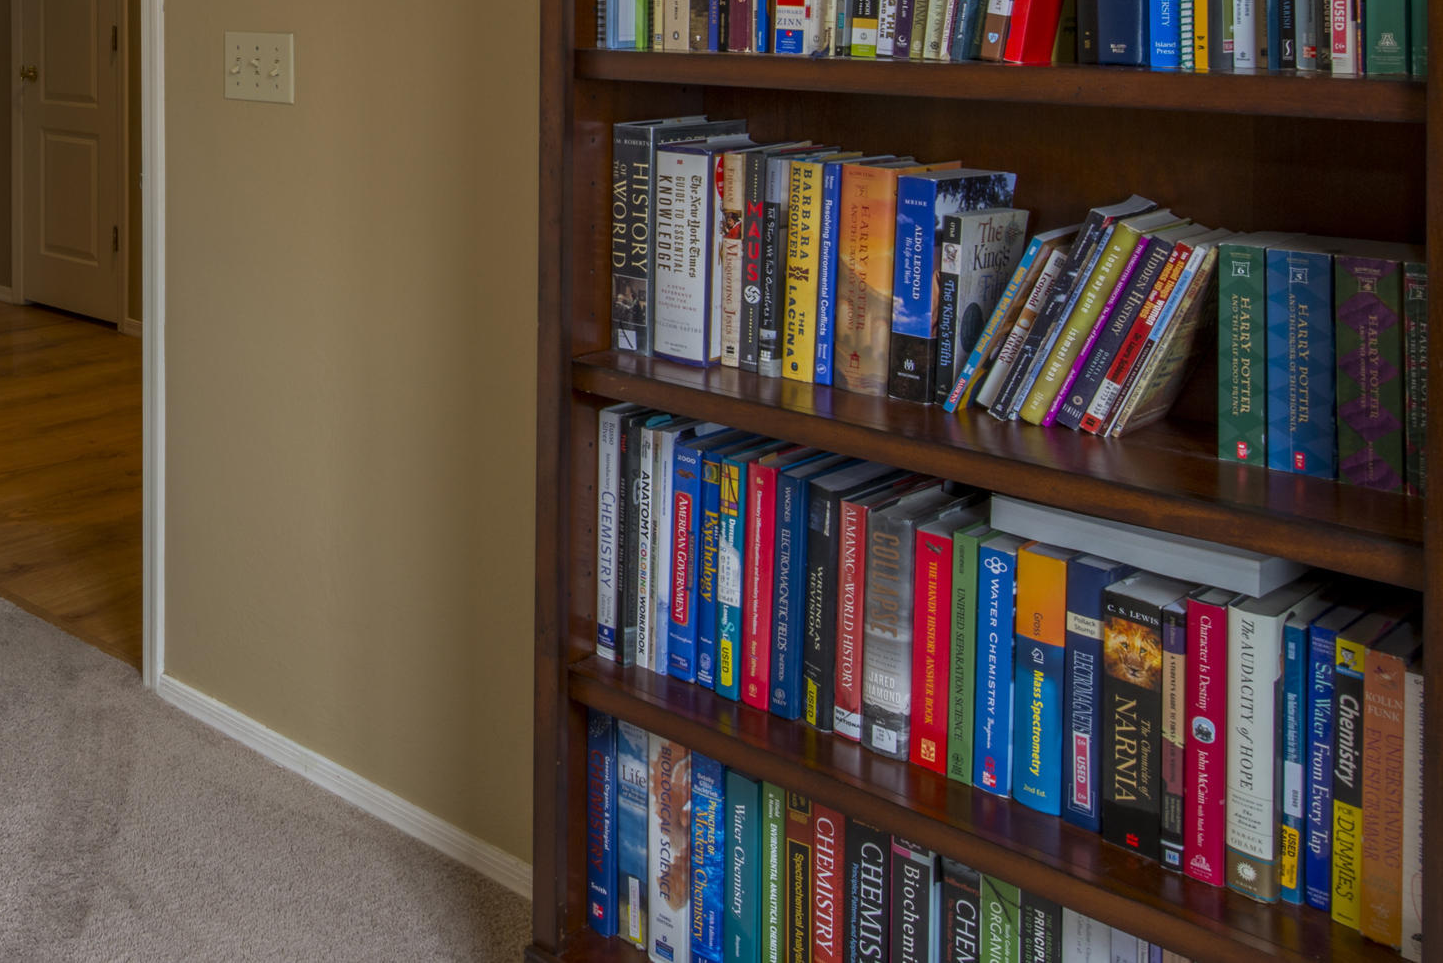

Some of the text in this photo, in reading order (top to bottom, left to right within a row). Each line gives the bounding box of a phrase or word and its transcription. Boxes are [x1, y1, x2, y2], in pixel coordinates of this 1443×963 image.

[776, 18, 803, 27] ZINN
[1155, 41, 1177, 49] Island
[1333, 0, 1345, 32] USED
[618, 163, 627, 176] OF
[789, 166, 802, 259] KINGSOLVER
[904, 199, 928, 207] MEINE
[612, 180, 627, 269] WORLD
[631, 162, 649, 273] HISTORY
[657, 174, 674, 273] KNOWLEDGE
[673, 175, 686, 274] GUIDE TO ESSENTIAL
[687, 174, 703, 279] The New York Times
[747, 200, 764, 282] MAUS
[799, 169, 813, 260] BARBARA
[978, 217, 1003, 244] The
[819, 199, 833, 336] Resolving Environmental Conflicts
[912, 224, 923, 300] ALDO LEOPOLD
[1029, 271, 1050, 310] Leopold
[1080, 292, 1096, 314] gone
[1091, 273, 1107, 296] way
[1102, 252, 1120, 275] long
[1110, 246, 1169, 336] HIDDEN HISTORY
[785, 286, 797, 358] LACUNA
[797, 311, 806, 337] THE
[940, 279, 955, 367] The King's Fifth
[1239, 295, 1252, 415] HARRY POTTER
[1296, 303, 1310, 424] HARRY POTTER
[1367, 314, 1379, 420] HARRY POTTER
[599, 491, 617, 590] CHEMISTRY
[637, 470, 651, 655] ANATOMY COLORING WORKBOOK
[678, 495, 690, 551] AMERICAN
[699, 508, 720, 604] Psychology
[674, 551, 688, 621] GOVERNMENT
[808, 572, 816, 637] REVISION
[840, 506, 858, 691] ALMANAC WORLD HISTORY
[871, 530, 900, 639] COLLAPSE
[1032, 612, 1044, 637] Gross
[1107, 603, 1160, 626] C. S. LEWIS
[721, 646, 730, 674] USED
[867, 670, 896, 688] JARED
[986, 578, 1000, 716] WATER CHEMISTRY
[1195, 614, 1211, 711] Character Is Destiny
[807, 689, 815, 718] USED
[1030, 669, 1045, 778] Mass Spectrometry
[1235, 618, 1254, 792] The AUDACITY of HOPE
[1334, 693, 1360, 788] Chemistry
[1364, 690, 1403, 710] KOLLN
[1367, 704, 1401, 722] FUNK
[621, 764, 647, 789] Life
[1076, 755, 1087, 784] USED
[1114, 693, 1137, 802] NARNIA
[1195, 748, 1208, 770] John
[1196, 771, 1208, 804] McCain
[1308, 661, 1334, 855] Safe Water From Every Tap
[590, 749, 605, 873] CHEMISTRY
[659, 745, 672, 902] BIOLOGICAL SCIENCE
[1287, 831, 1297, 859] USED
[1383, 734, 1403, 869] UNDERSTANDING
[691, 806, 708, 943] Modern Chemistry
[732, 803, 745, 919] Water Chemistry
[816, 816, 835, 958] CHEMISTRY
[1335, 816, 1356, 905] DUMMIES
